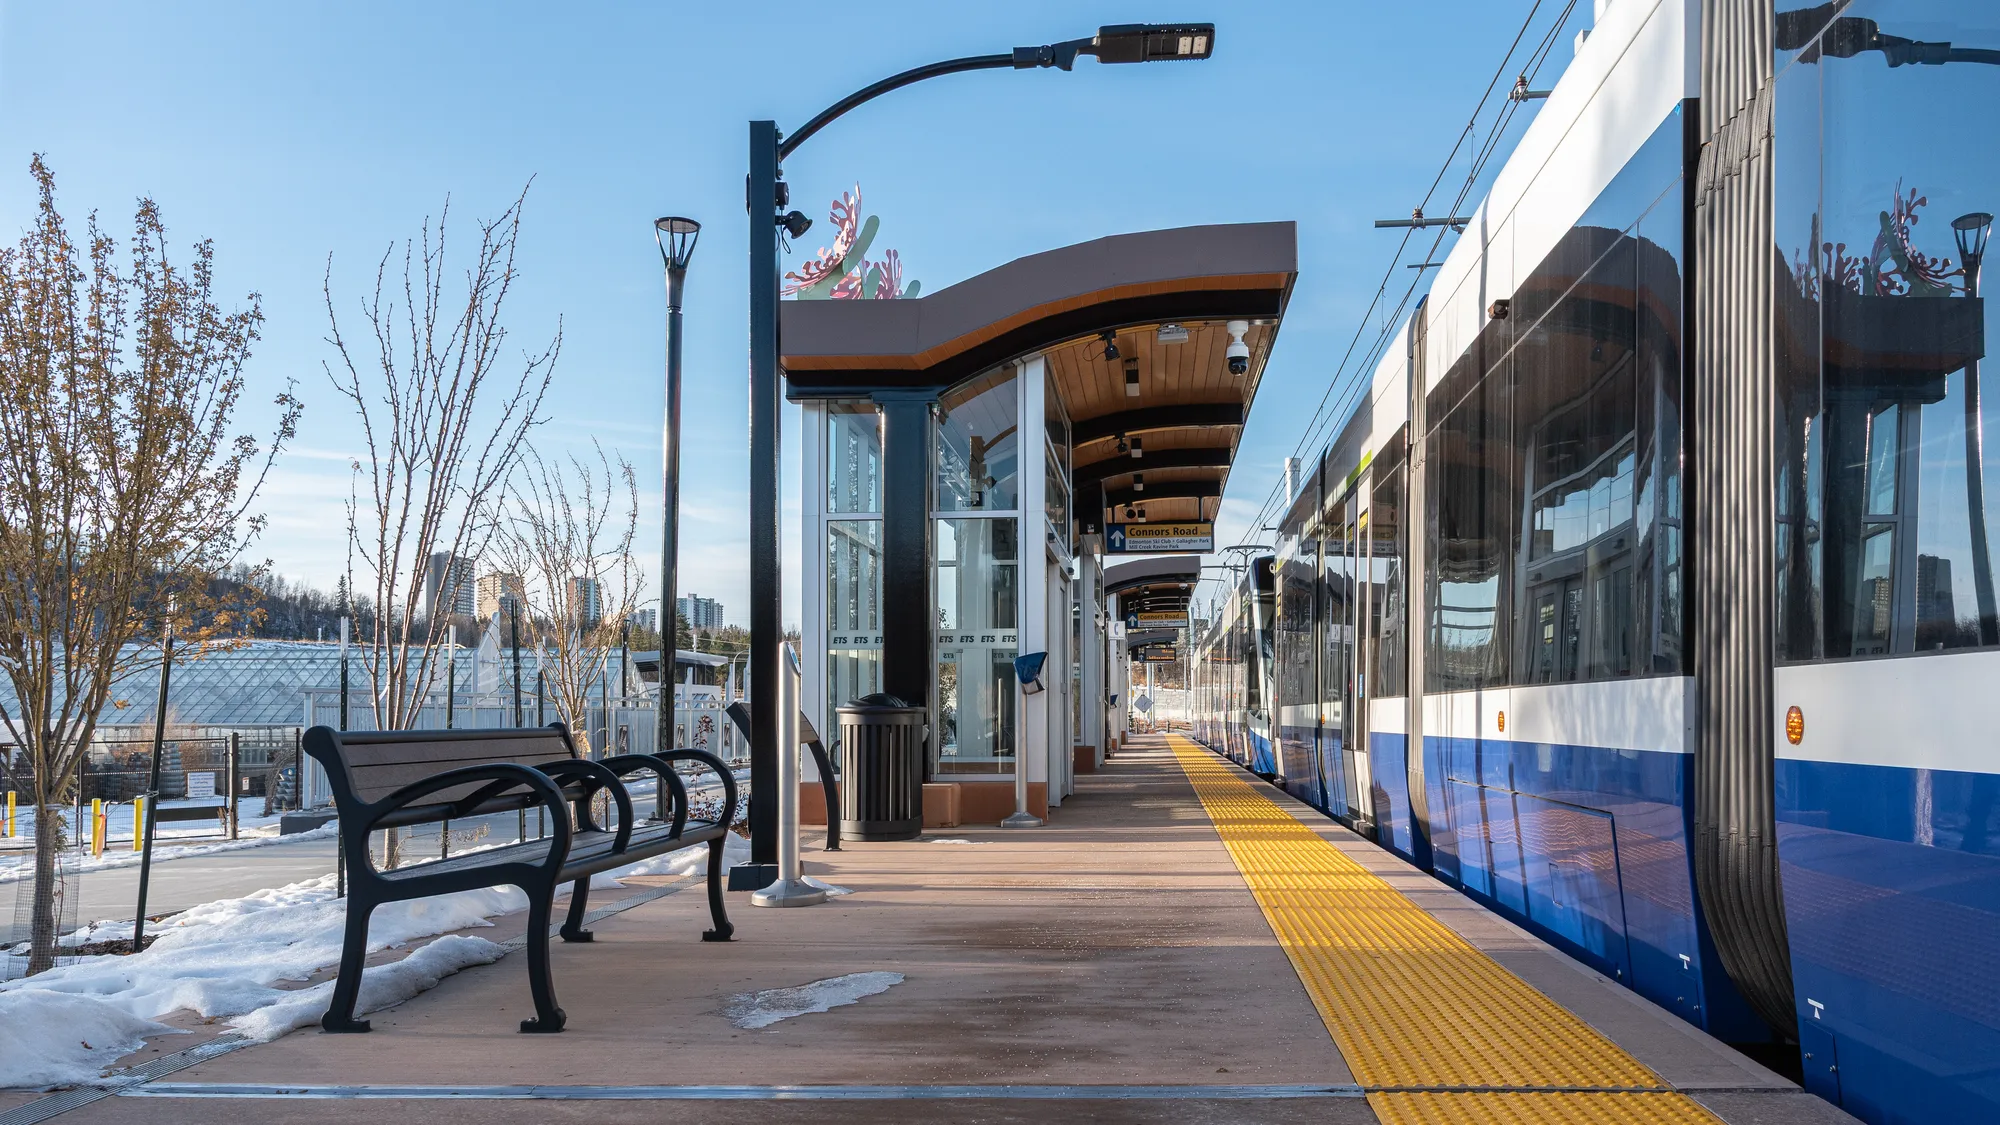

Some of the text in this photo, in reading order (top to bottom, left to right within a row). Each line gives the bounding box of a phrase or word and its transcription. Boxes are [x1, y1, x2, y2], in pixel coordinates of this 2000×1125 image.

[1129, 527, 1170, 537] Connors
[1173, 526, 1198, 536] Road
[833, 636, 848, 644] ETS
[853, 636, 868, 644] ETS
[939, 635, 1017, 643] ETS ETS ETS ETS
